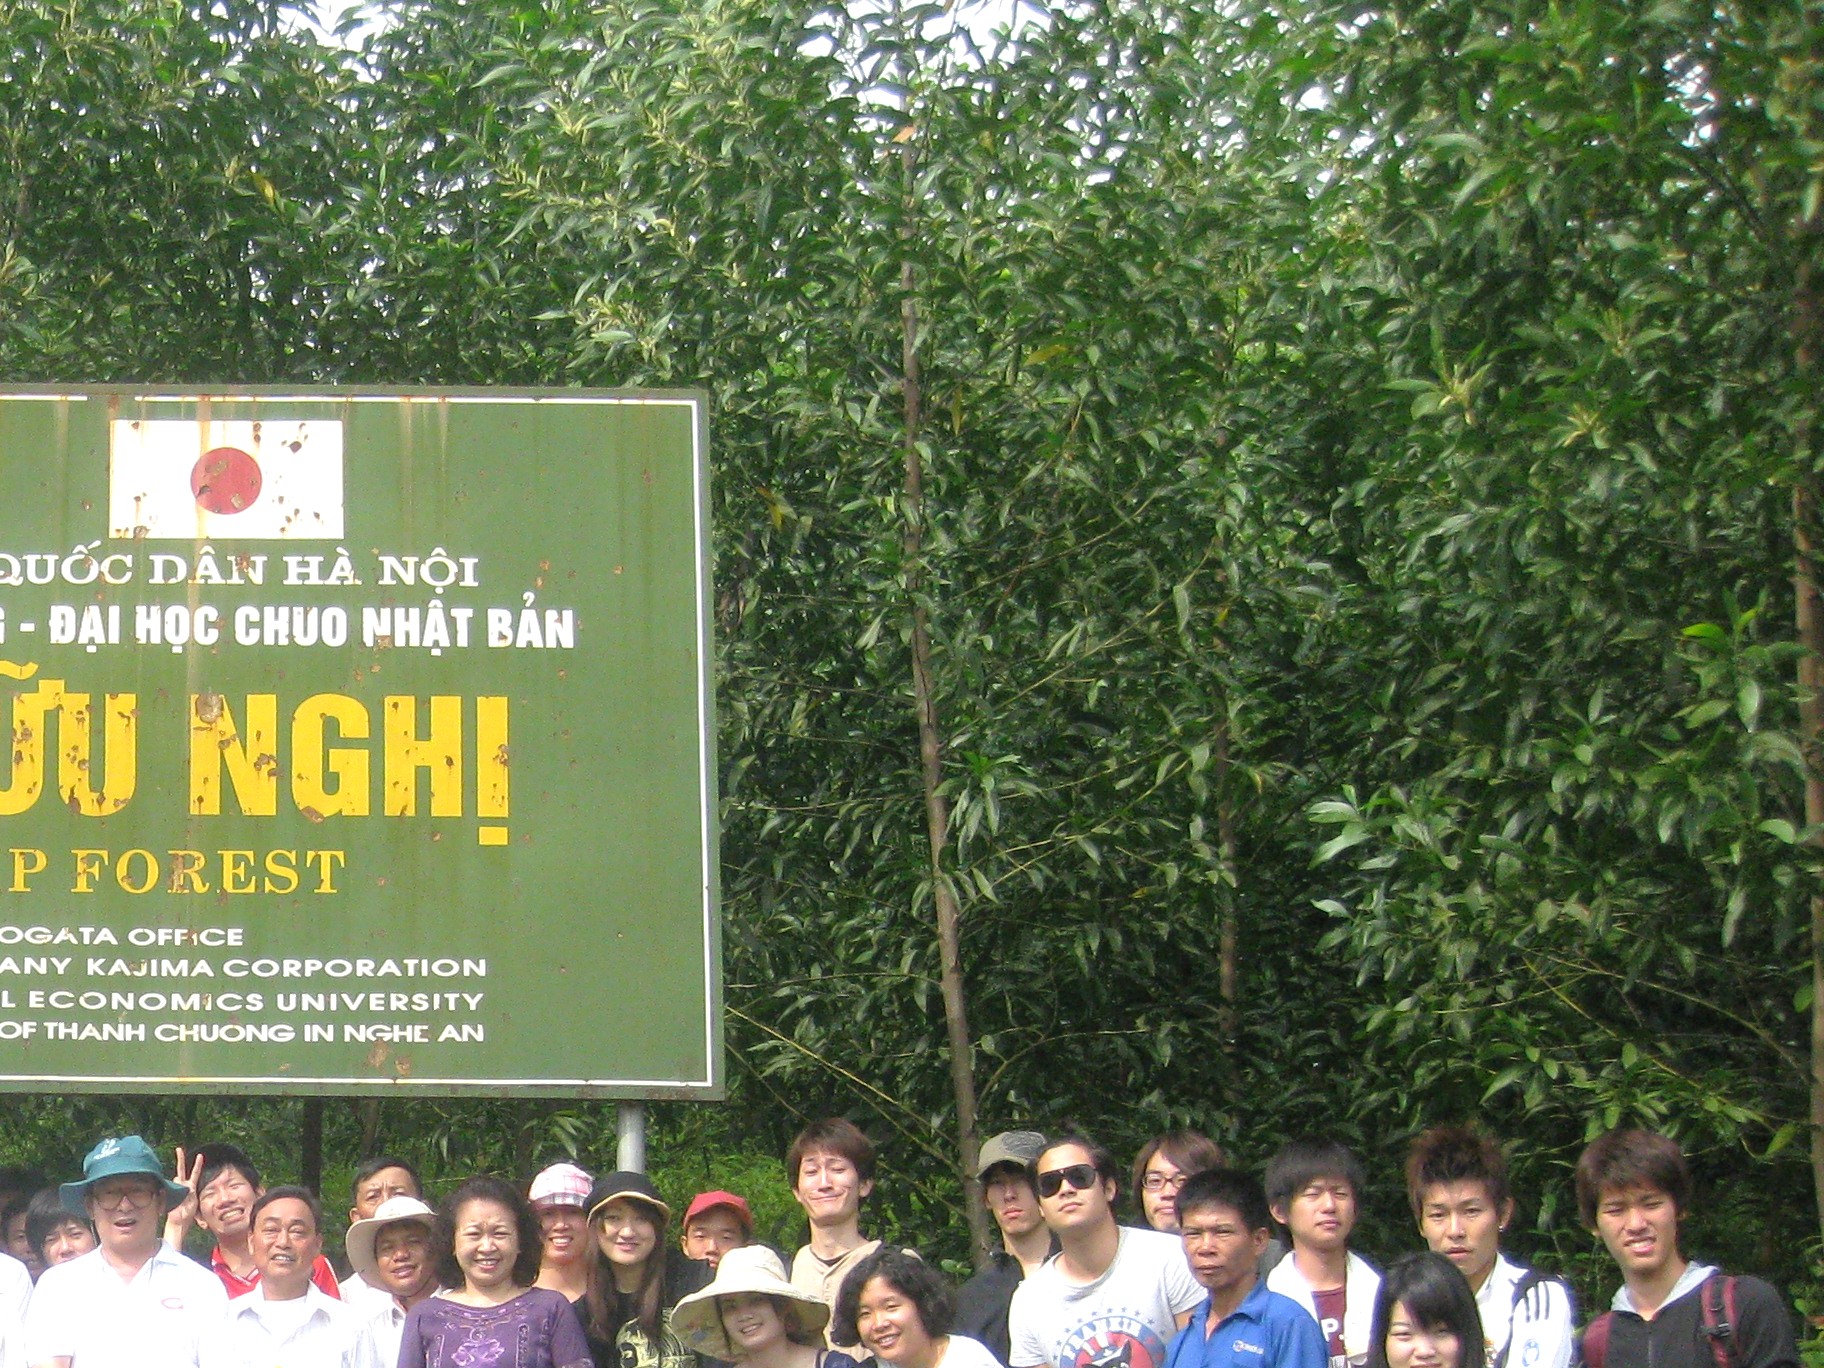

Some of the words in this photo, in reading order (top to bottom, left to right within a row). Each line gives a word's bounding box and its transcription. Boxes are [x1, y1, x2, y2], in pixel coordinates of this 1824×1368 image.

[148, 545, 268, 585] DÂN
[282, 546, 363, 586] HÀ
[378, 546, 479, 594] NỘI
[48, 604, 121, 653] ĐẠI
[135, 604, 219, 654] HỌC
[234, 604, 348, 647] CHUO
[362, 598, 474, 657] NHẬT
[487, 591, 575, 649] BẢN
[189, 693, 510, 846] NGHỊ
[71, 849, 345, 894] FOREST
[127, 927, 244, 947] OFFICE
[87, 957, 215, 977] KAJIMA
[222, 958, 486, 978] CORPORATION
[28, 990, 264, 1012] ECONOMICS
[276, 992, 484, 1012] UNIVERSITY
[43, 1021, 146, 1042] THANH
[154, 1023, 296, 1043] CHUONG
[303, 1024, 334, 1042] IN
[343, 1024, 429, 1043] NGHE
[437, 1023, 484, 1042] AN
